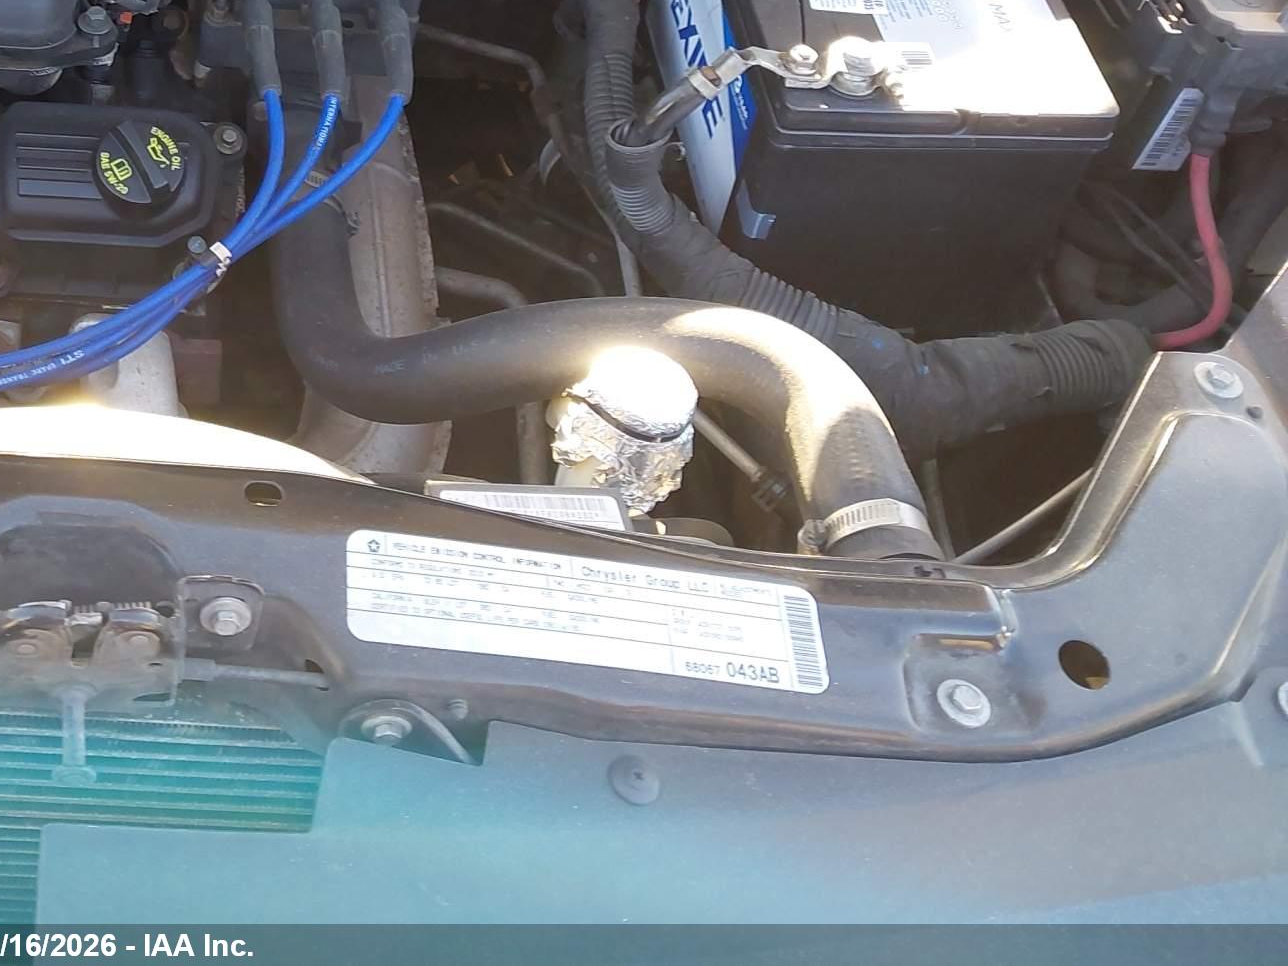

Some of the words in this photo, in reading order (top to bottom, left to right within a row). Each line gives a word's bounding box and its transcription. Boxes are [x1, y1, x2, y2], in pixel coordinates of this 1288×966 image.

[100, 152, 111, 169] SAE
[151, 126, 178, 154] ENGINE
[171, 156, 182, 170] OIL
[581, 565, 637, 583] Chrysler
[645, 574, 680, 590] Group
[687, 581, 710, 593] LLC
[726, 661, 780, 684] 043AB
